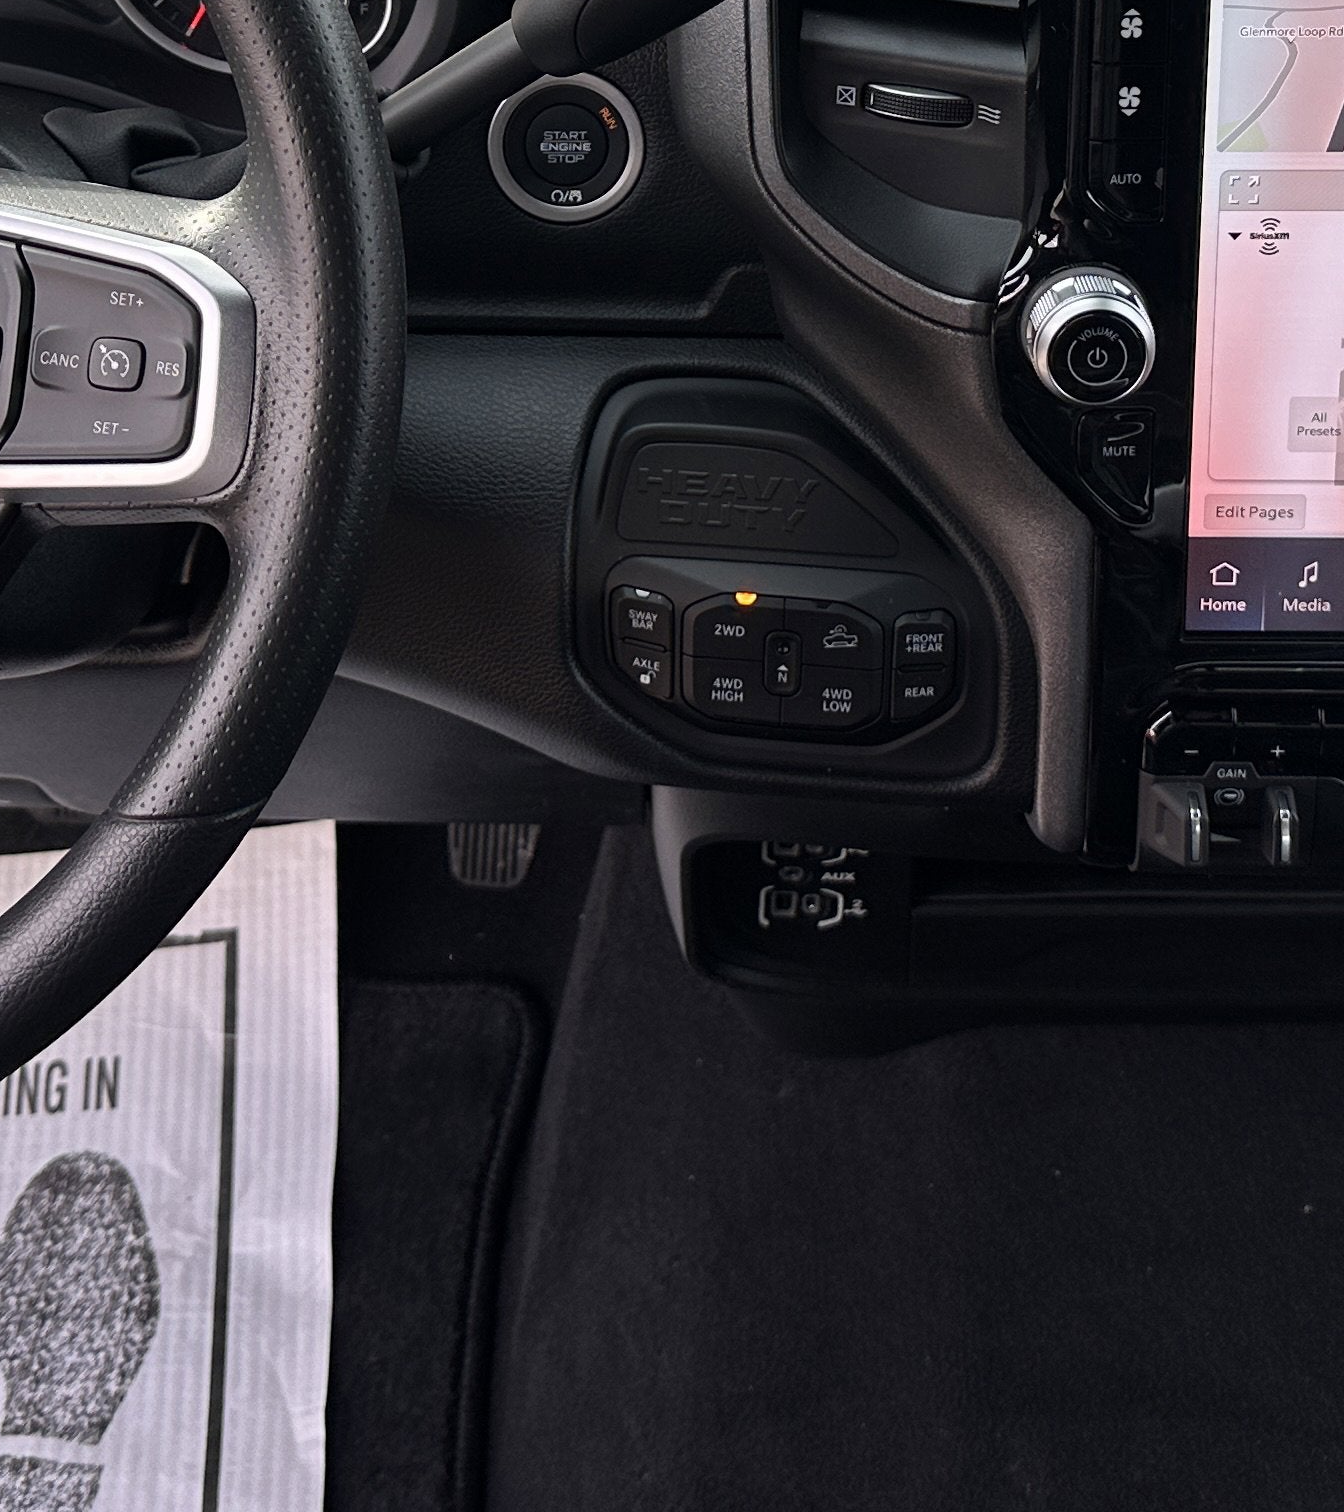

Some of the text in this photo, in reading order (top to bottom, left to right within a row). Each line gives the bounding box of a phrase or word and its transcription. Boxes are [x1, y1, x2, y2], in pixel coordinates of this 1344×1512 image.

[1240, 27, 1344, 39] Glenmore Loop Rd
[599, 107, 619, 130] RUN
[543, 131, 587, 140] START
[540, 142, 592, 152] ENGINE
[548, 154, 585, 163] STOP
[1110, 174, 1141, 185] AUTO
[1078, 327, 1120, 342] VOLUME
[40, 351, 79, 369] CANC
[156, 361, 180, 377] RES
[1311, 412, 1328, 423] All
[1297, 426, 1341, 437] Presets
[1103, 446, 1136, 456] MUTE
[639, 468, 819, 503] HEAVY
[660, 499, 805, 532] DUTY
[1216, 505, 1294, 523] Edit Pages
[1200, 597, 1247, 613] Home
[1283, 597, 1331, 613] Media
[629, 609, 658, 622] SWAY
[632, 619, 653, 631] BAR
[714, 624, 745, 637] 2WD
[906, 634, 944, 644] FRONT
[632, 656, 660, 671] AXLE
[712, 677, 743, 690] 4WD
[777, 673, 787, 683] N
[711, 690, 744, 702] HIGH
[822, 688, 852, 701] 4WD
[904, 687, 934, 698] REAR
[822, 700, 852, 713] LOW
[1217, 768, 1246, 778] GAIN
[821, 872, 856, 881] AUX
[83, 1055, 121, 1111] IN
